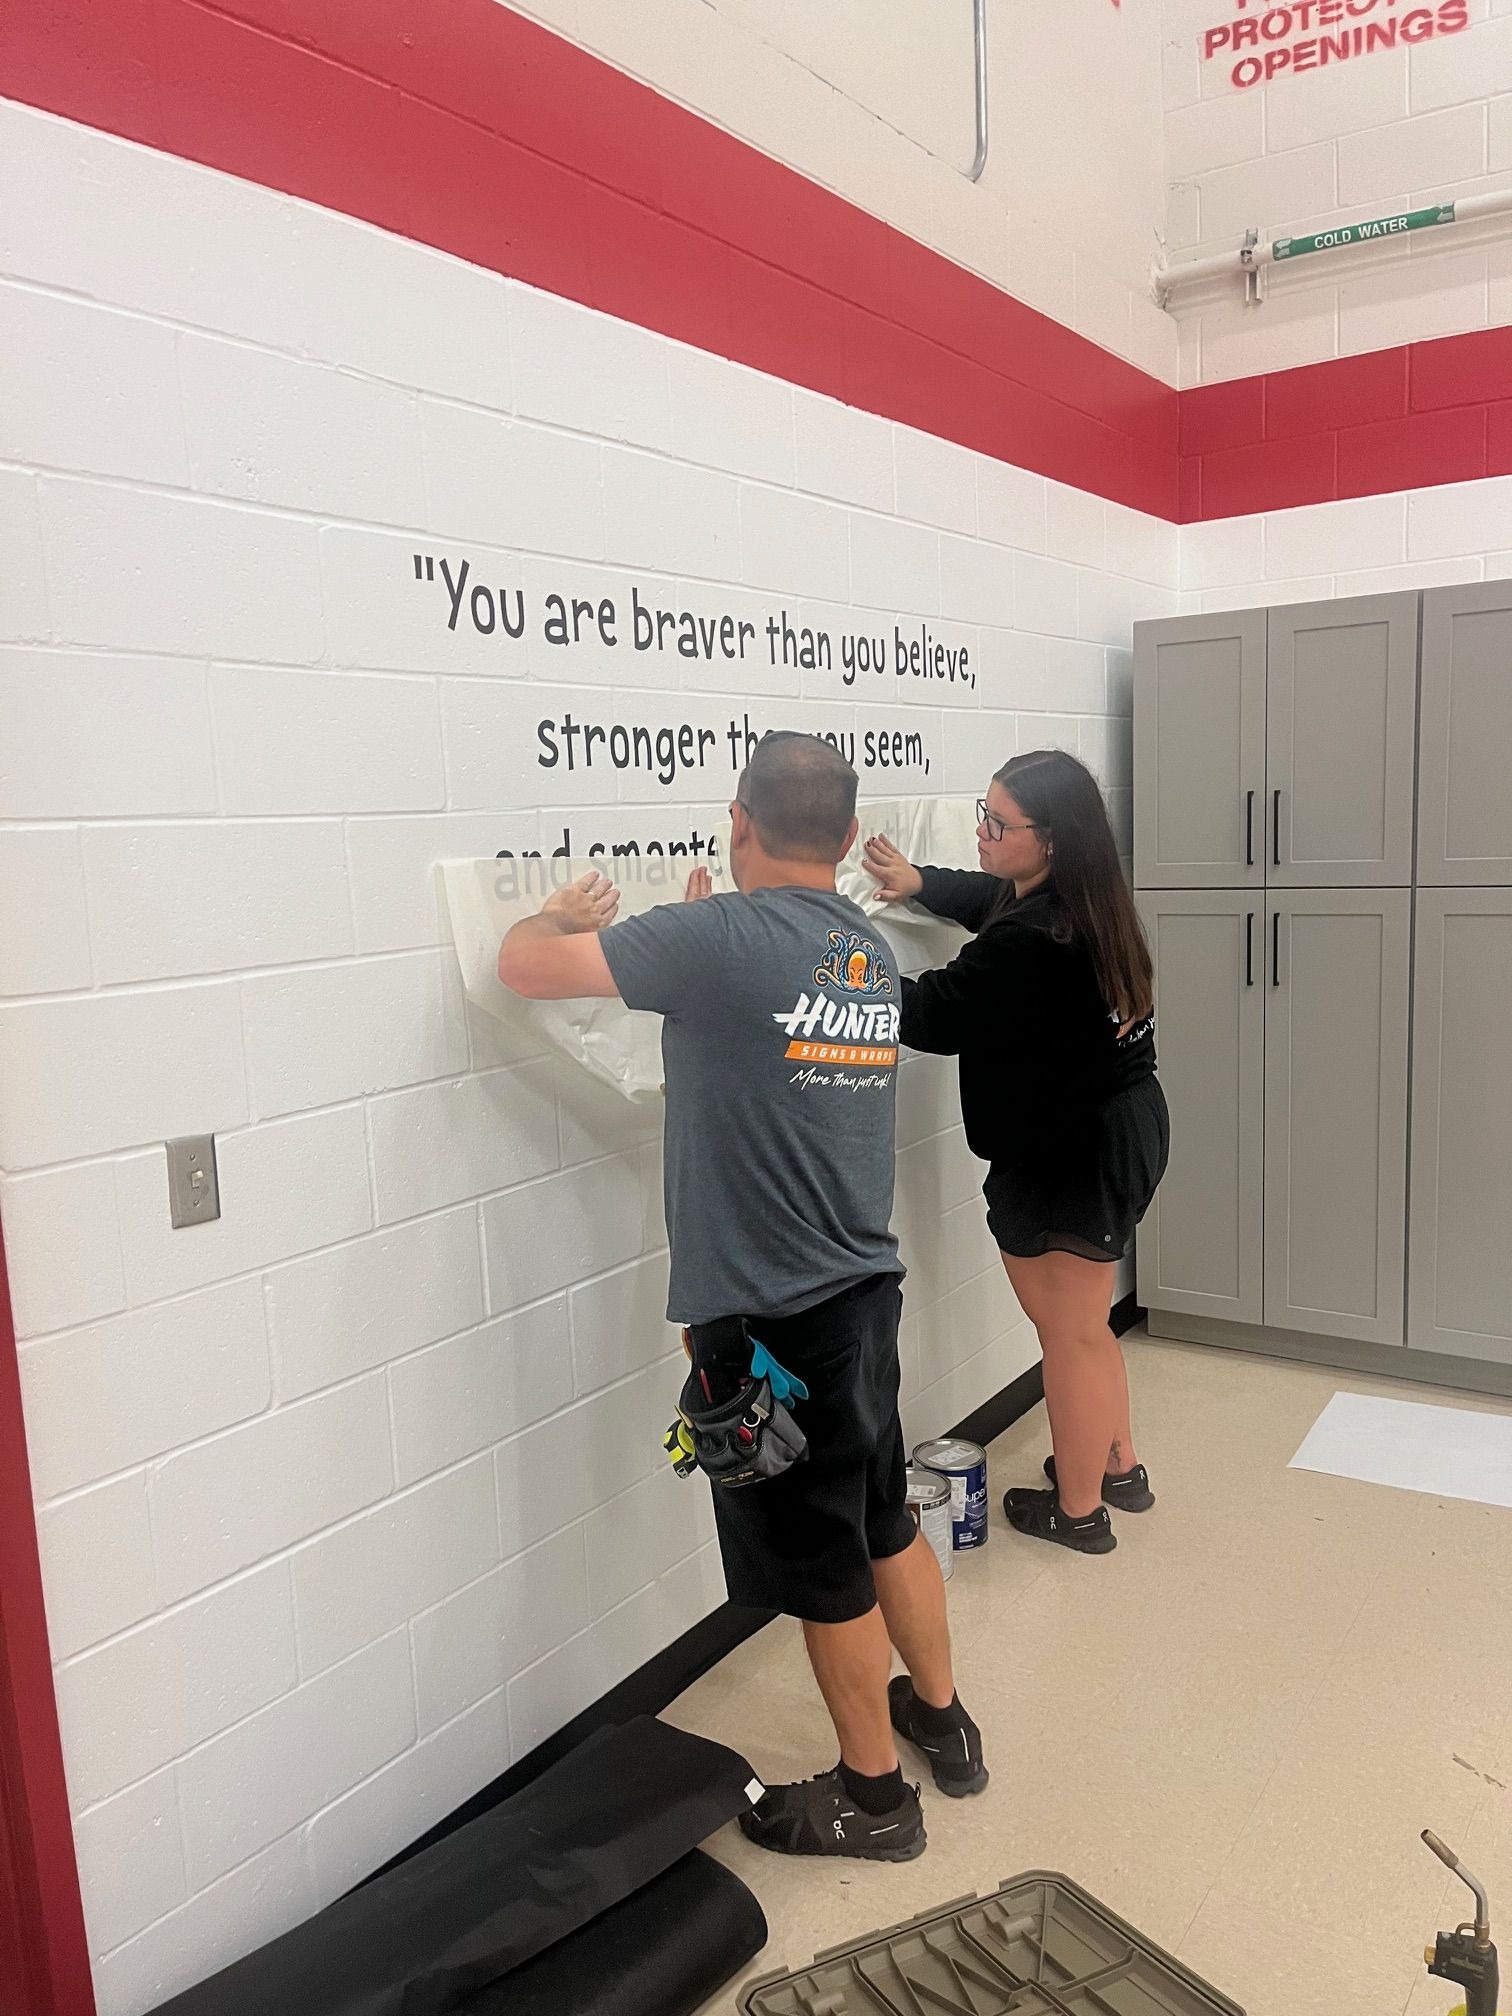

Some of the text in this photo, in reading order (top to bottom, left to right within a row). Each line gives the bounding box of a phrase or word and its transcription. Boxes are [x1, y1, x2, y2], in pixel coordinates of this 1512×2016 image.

[1205, 0, 1397, 59] PROTE
[1231, 0, 1469, 88] OPENINGS
[1314, 217, 1408, 249] COLD WATER
[544, 593, 618, 647] are
[631, 586, 755, 660] braver
[766, 610, 832, 670] than
[841, 634, 886, 686] you
[894, 623, 976, 690] believe,
[537, 713, 716, 786] stronger
[727, 713, 775, 771] th
[864, 730, 930, 776] seem,
[772, 991, 900, 1043] HUNTER
[789, 1066, 831, 1090] More
[852, 1073, 876, 1092] just
[801, 1045, 846, 1060] SIGNS
[860, 1050, 893, 1062] WRAPS
